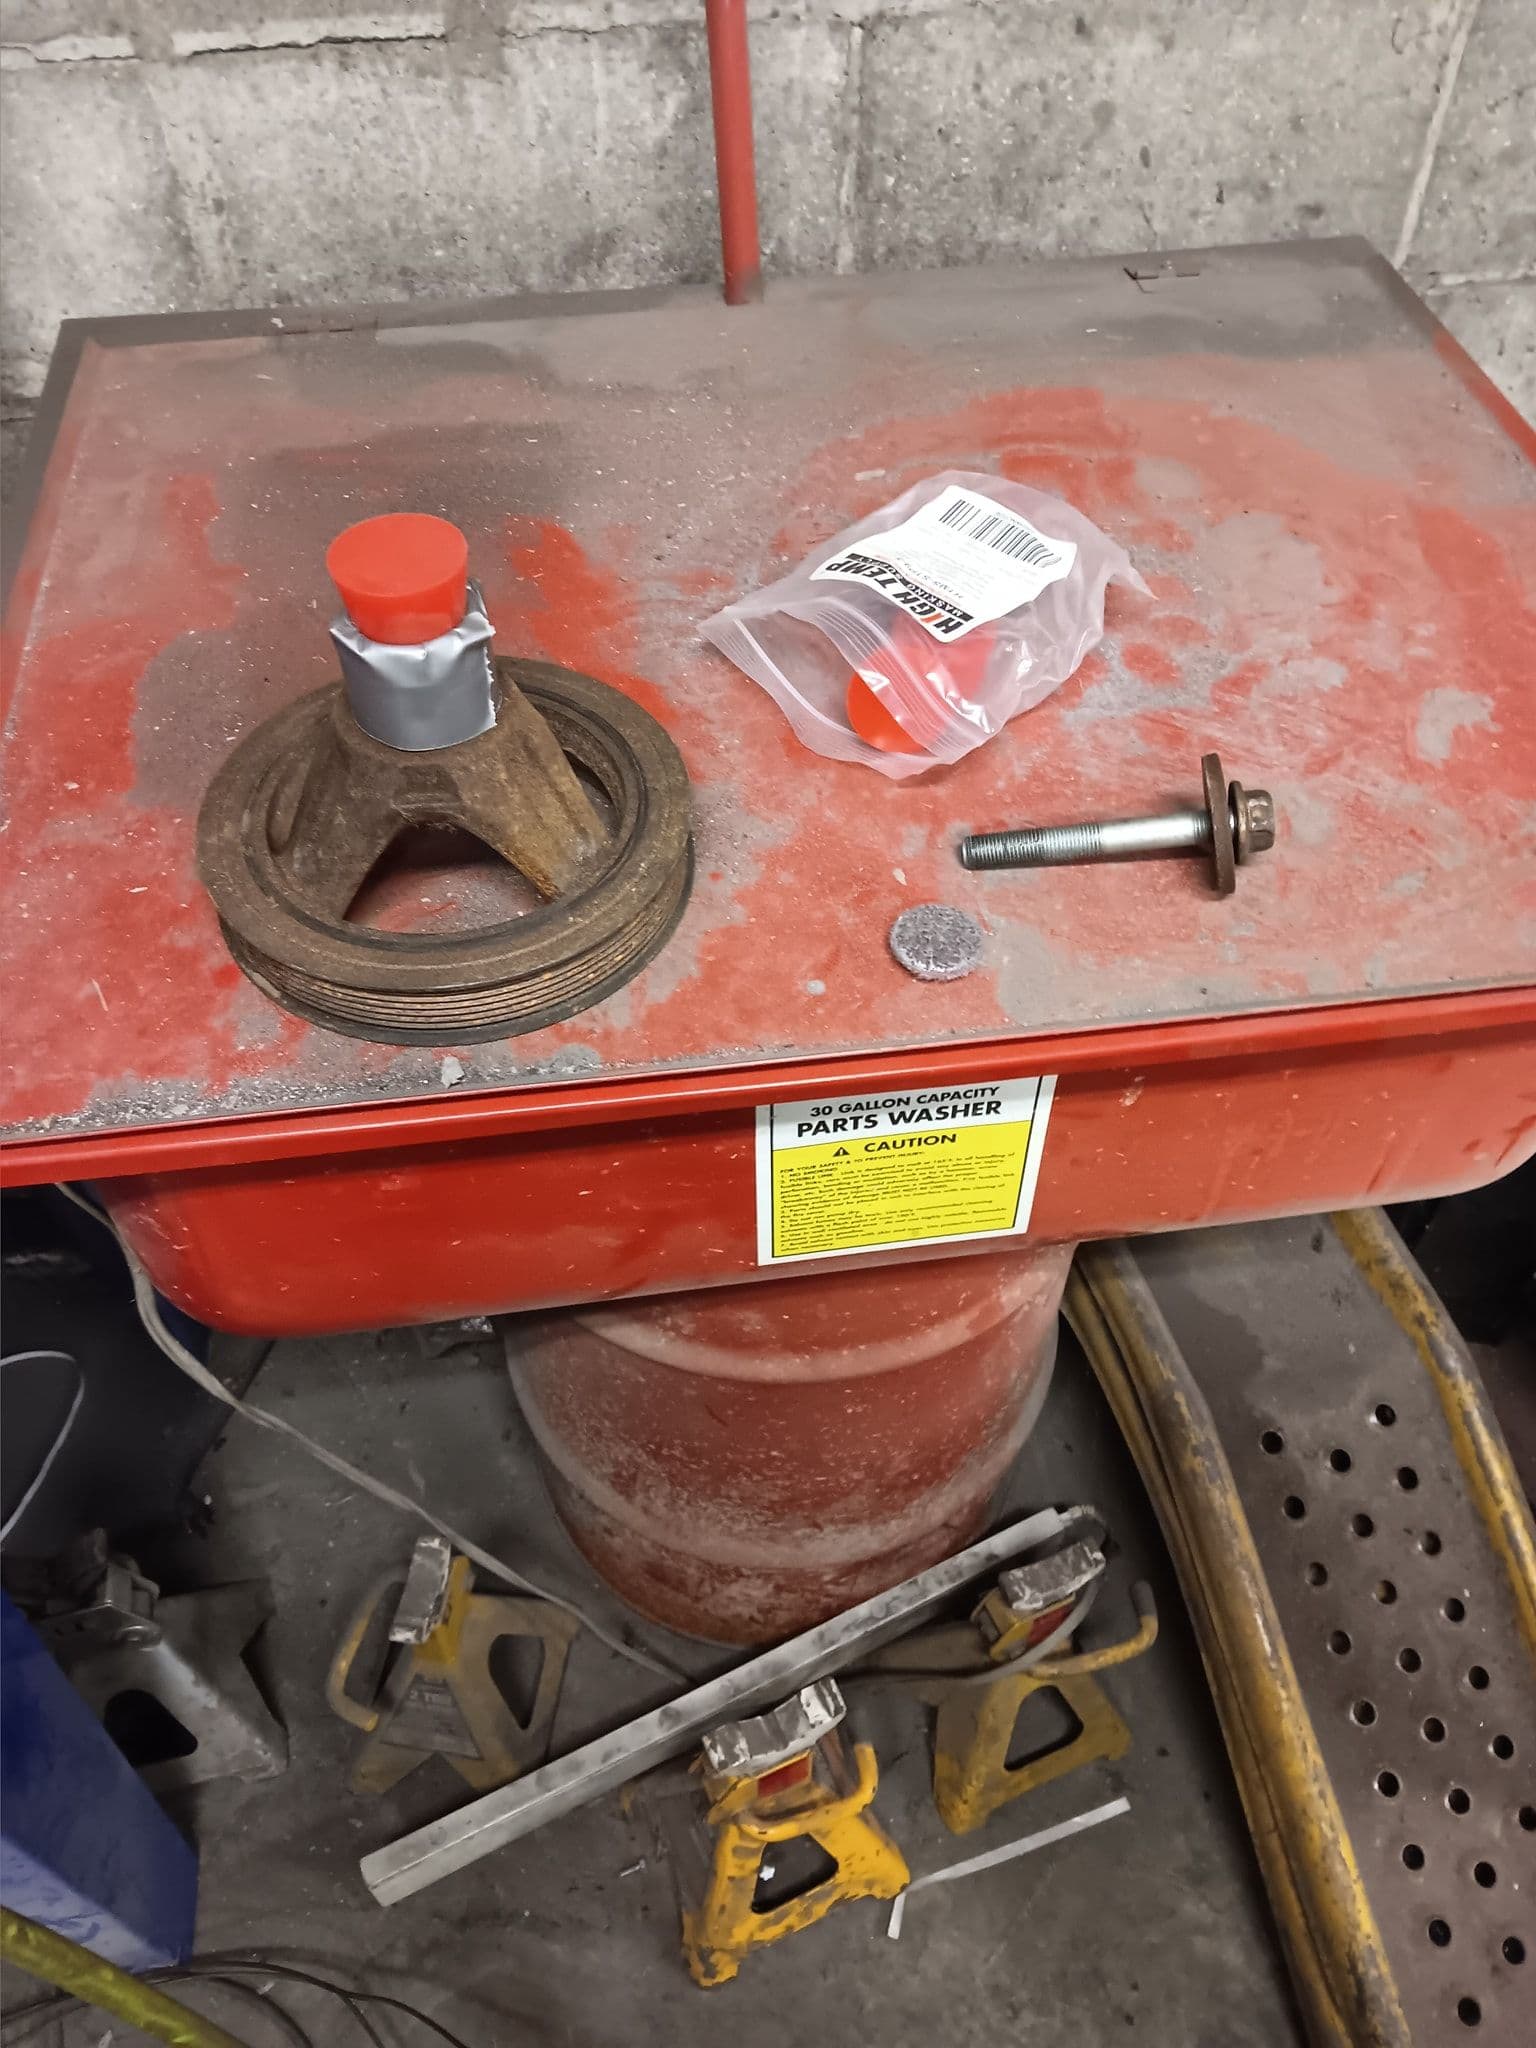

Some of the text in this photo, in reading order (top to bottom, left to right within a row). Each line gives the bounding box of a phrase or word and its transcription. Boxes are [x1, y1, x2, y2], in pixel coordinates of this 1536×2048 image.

[826, 560, 898, 589] TEMP
[893, 591, 964, 634] HIGH
[907, 583, 964, 617] MASKING
[810, 1086, 1000, 1117] 30 GALLON CAPACITY
[797, 1100, 1002, 1137] PARTS WASHER
[863, 1133, 957, 1153] CAUTION
